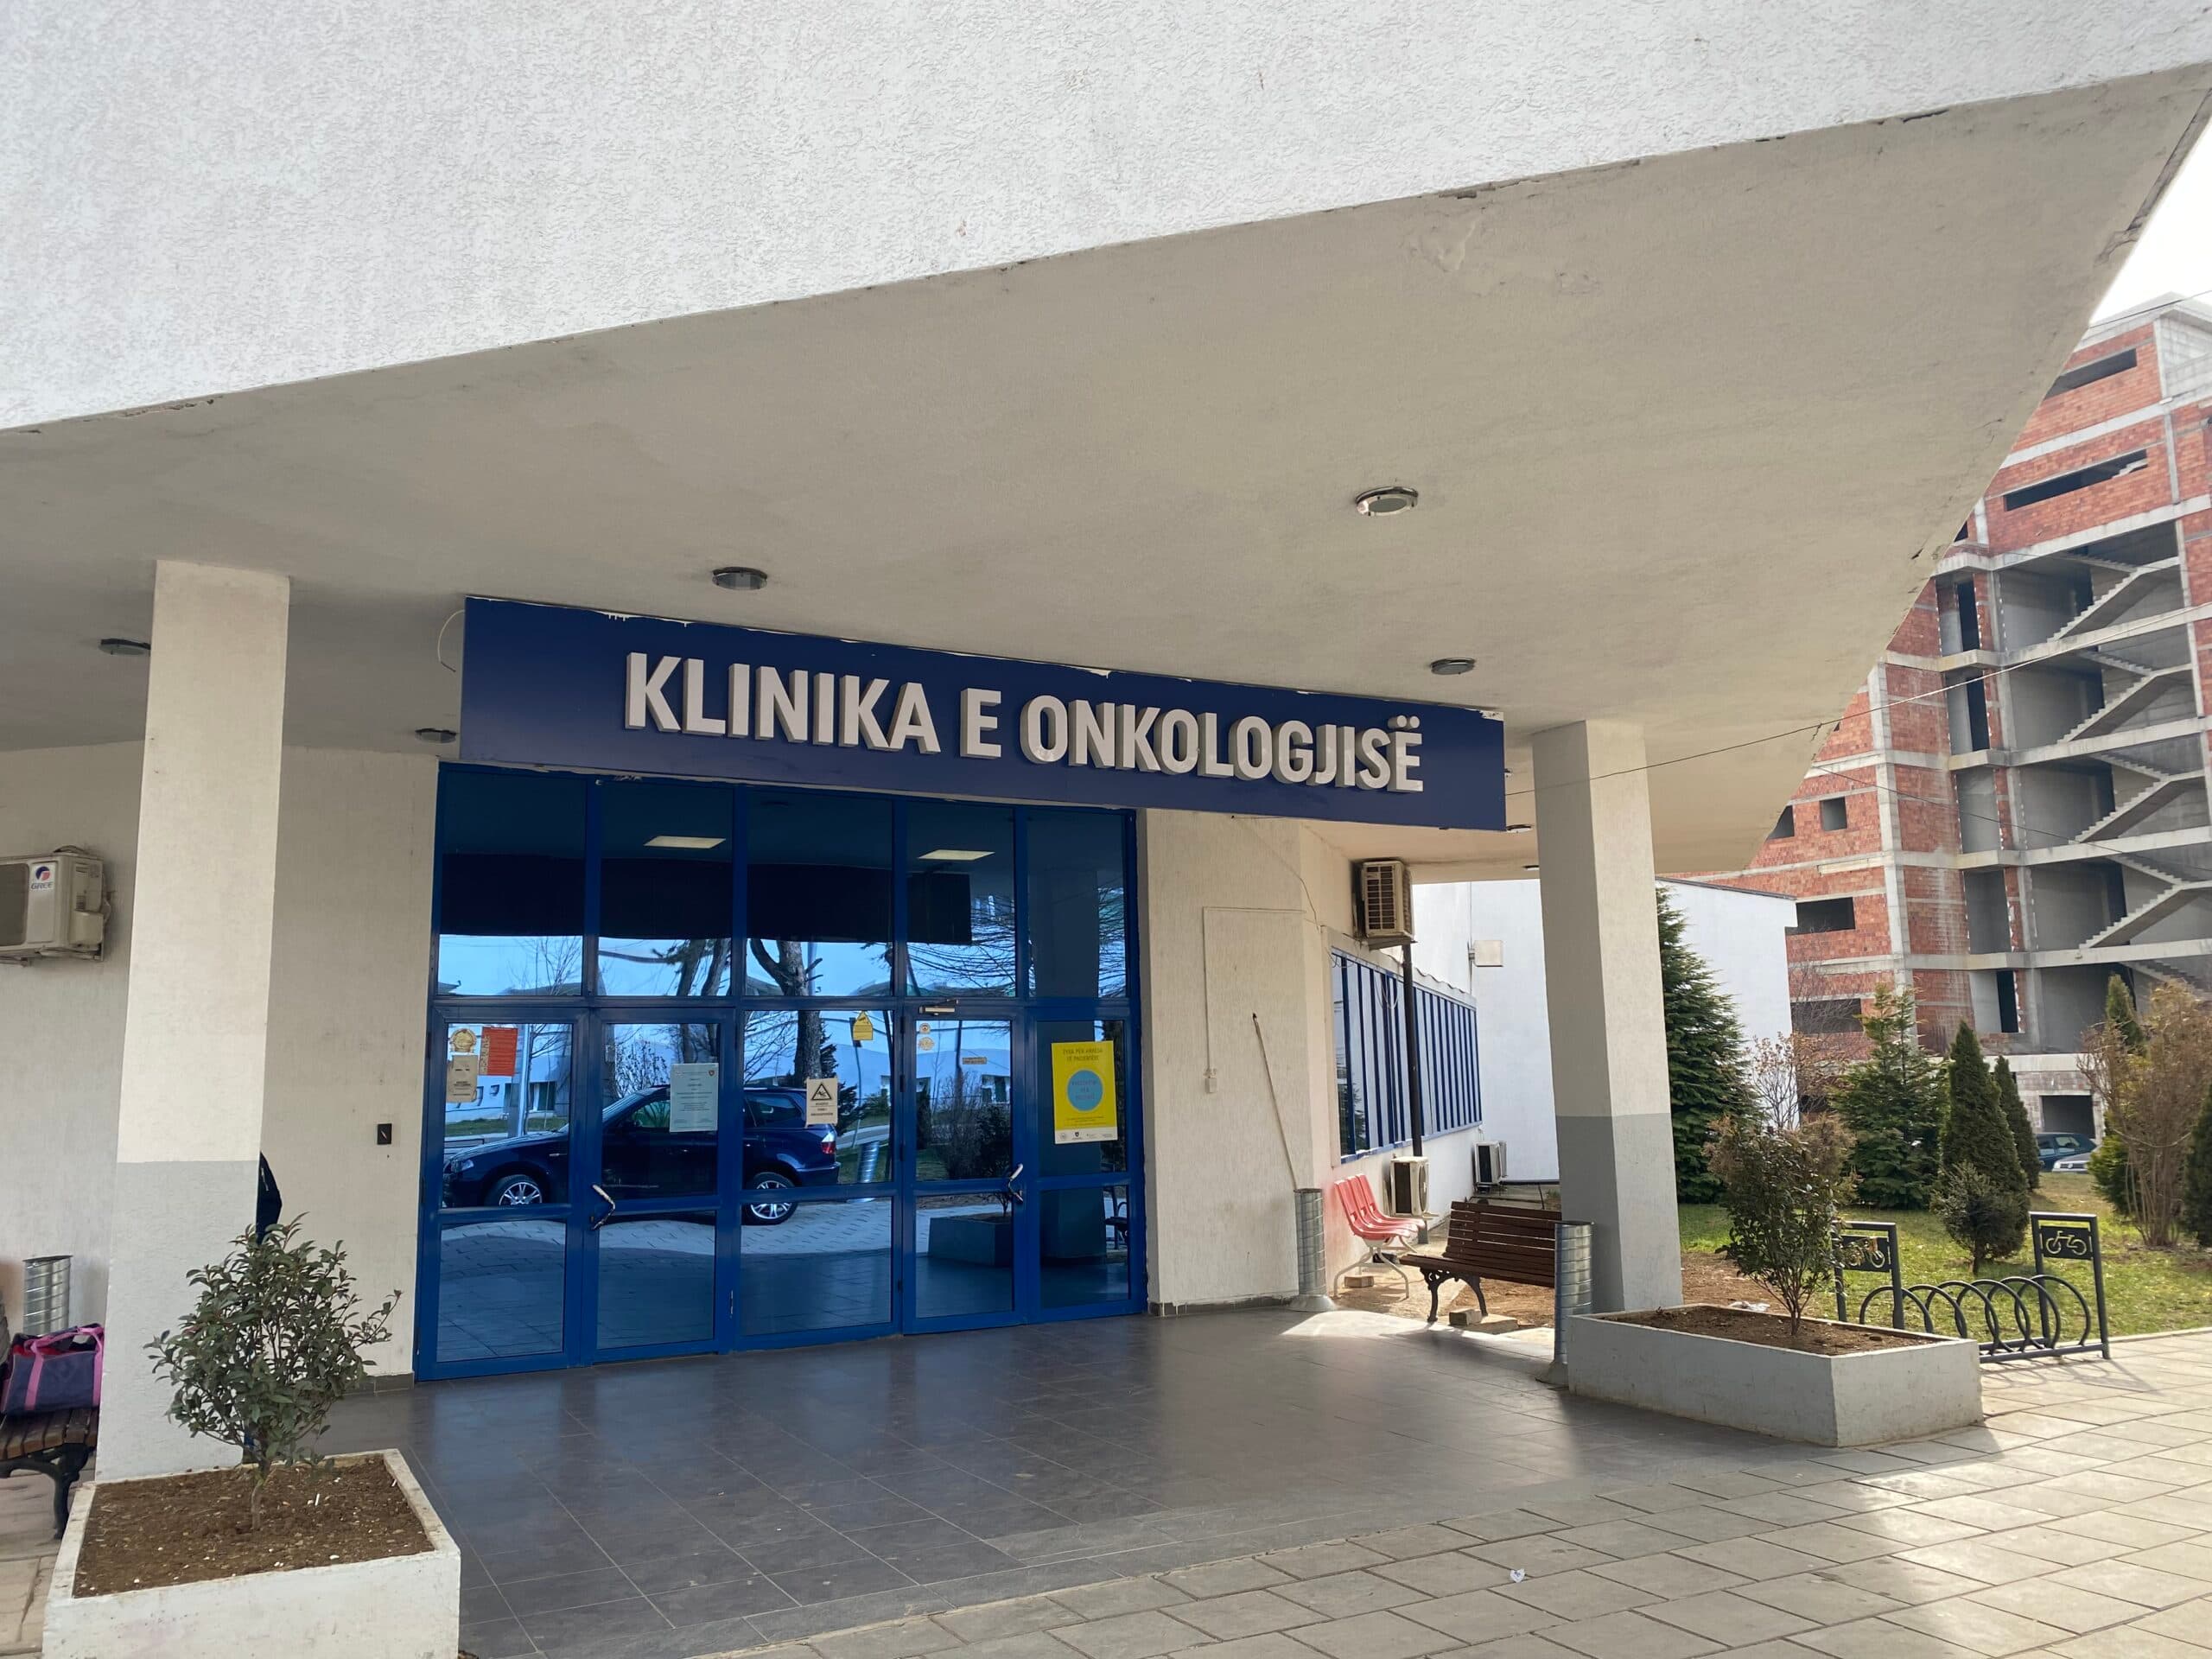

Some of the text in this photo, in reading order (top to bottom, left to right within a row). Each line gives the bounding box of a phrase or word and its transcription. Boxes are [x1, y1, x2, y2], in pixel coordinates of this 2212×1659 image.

[624, 652, 1424, 793] KLINIKA E ONKOLOGJISË
